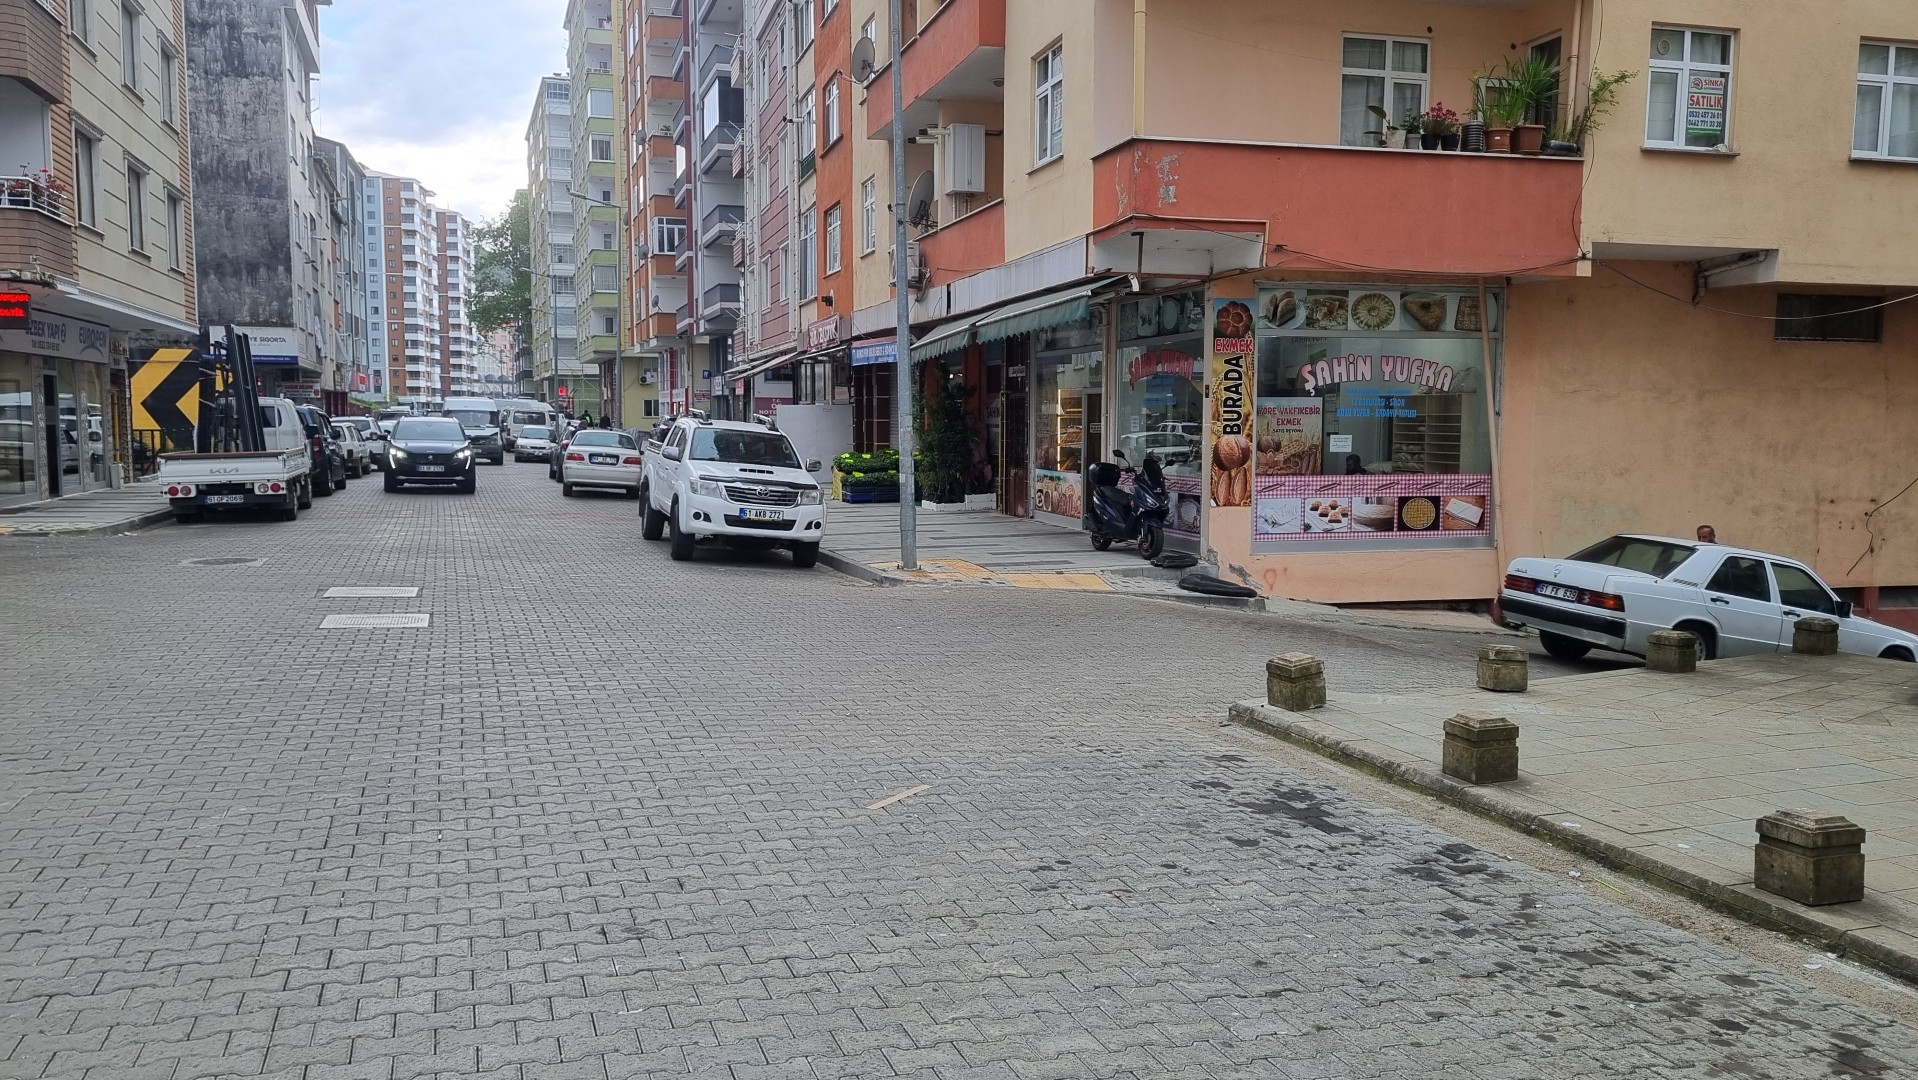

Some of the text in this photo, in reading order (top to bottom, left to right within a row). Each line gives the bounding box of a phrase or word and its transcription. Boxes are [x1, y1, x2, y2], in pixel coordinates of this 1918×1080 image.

[1704, 78, 1723, 87] SİNKA
[1689, 94, 1723, 108] SATILIK
[1701, 111, 1710, 119] 457
[46, 322, 60, 340] YAPI
[79, 326, 107, 348] EUROPEN
[1215, 338, 1253, 353] EKMEK
[1300, 354, 1454, 396] ŞAHİN YUFKA
[1222, 354, 1244, 435] BURADA
[1276, 418, 1302, 426] EKMEK
[754, 510, 766, 518] AKB
[1540, 584, 1577, 600] 61 FK 639
